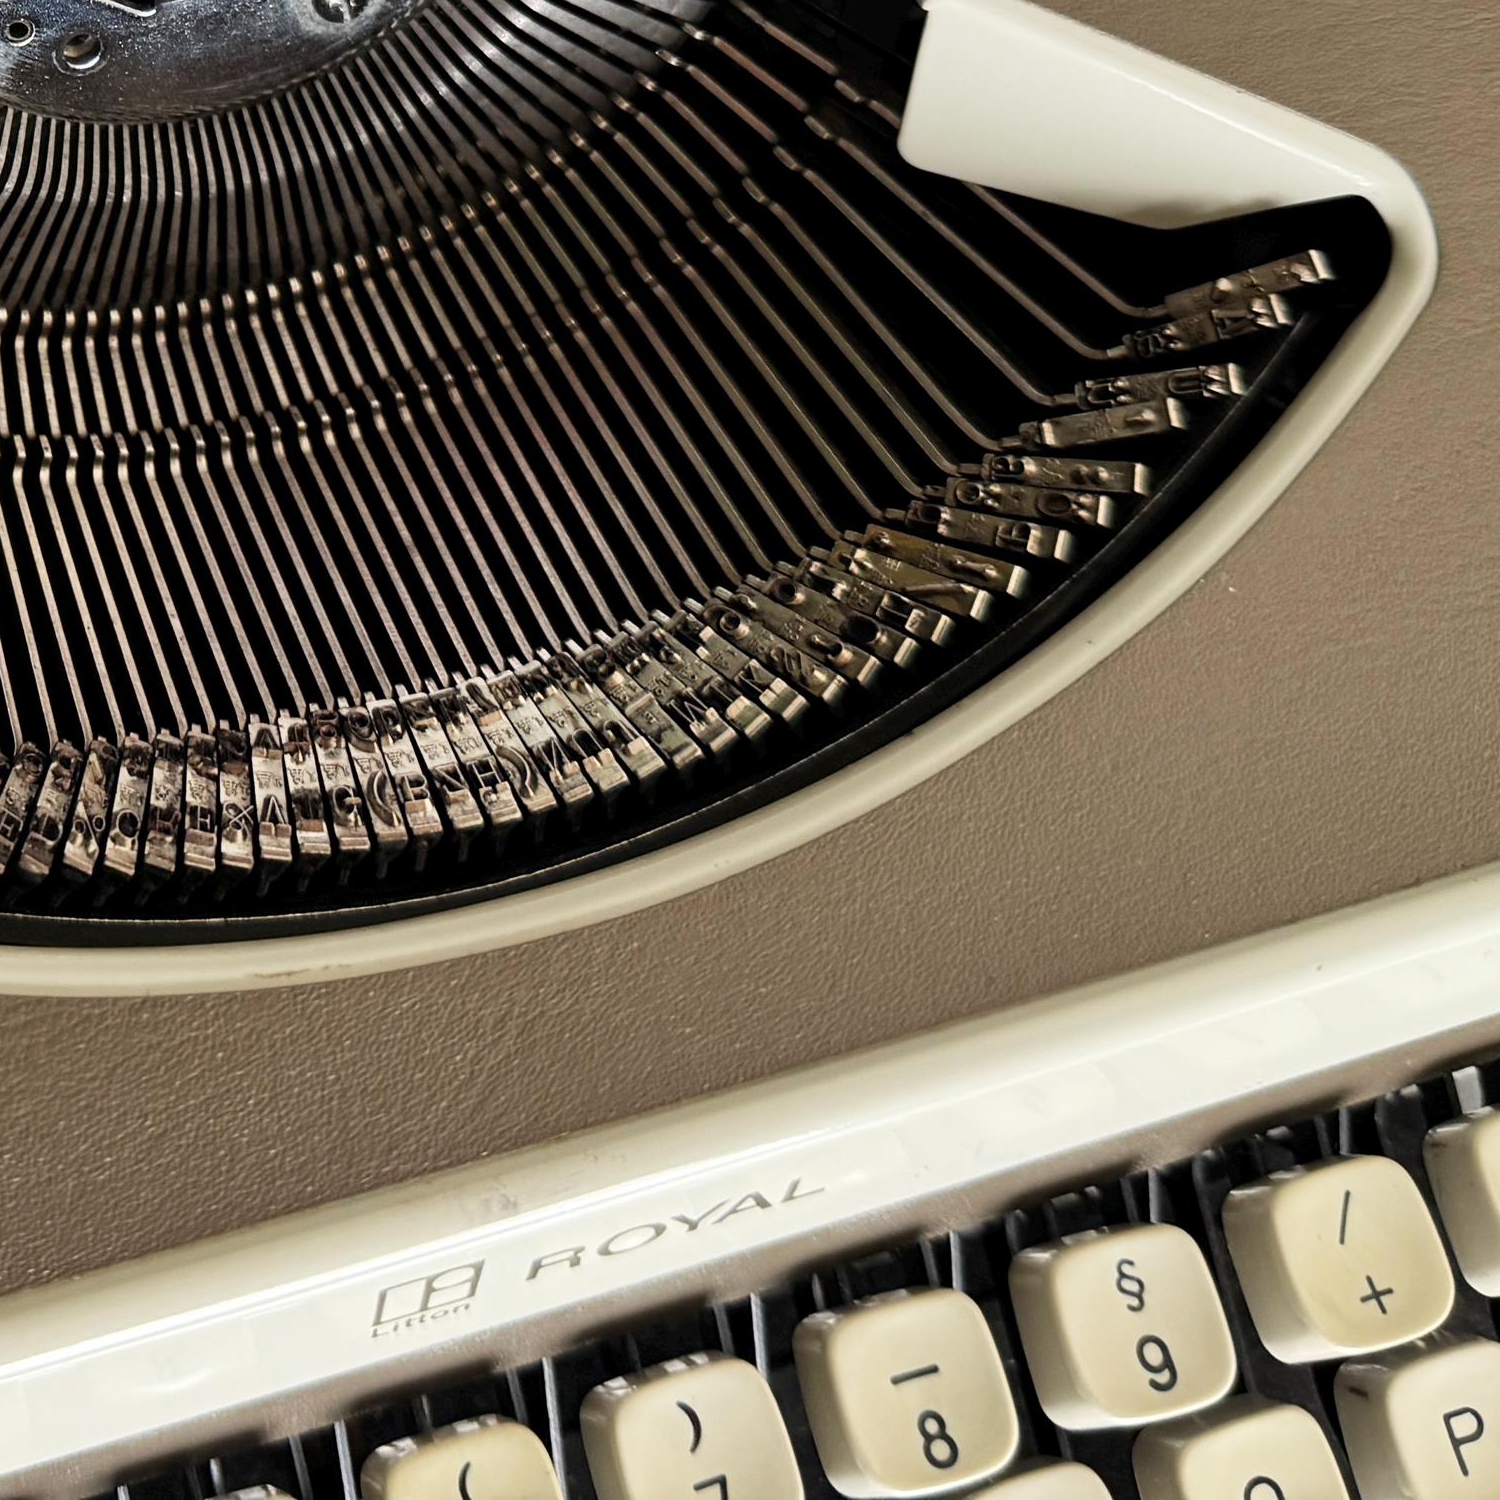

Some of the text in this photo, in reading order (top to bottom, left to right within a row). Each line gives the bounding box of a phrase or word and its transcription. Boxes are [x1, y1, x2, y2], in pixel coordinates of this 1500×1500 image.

[372, 1177, 825, 1338] Litton ROYAL
[1136, 1334, 1178, 1392] 9
[917, 1409, 959, 1469] 8
[1443, 1406, 1484, 1477] P
